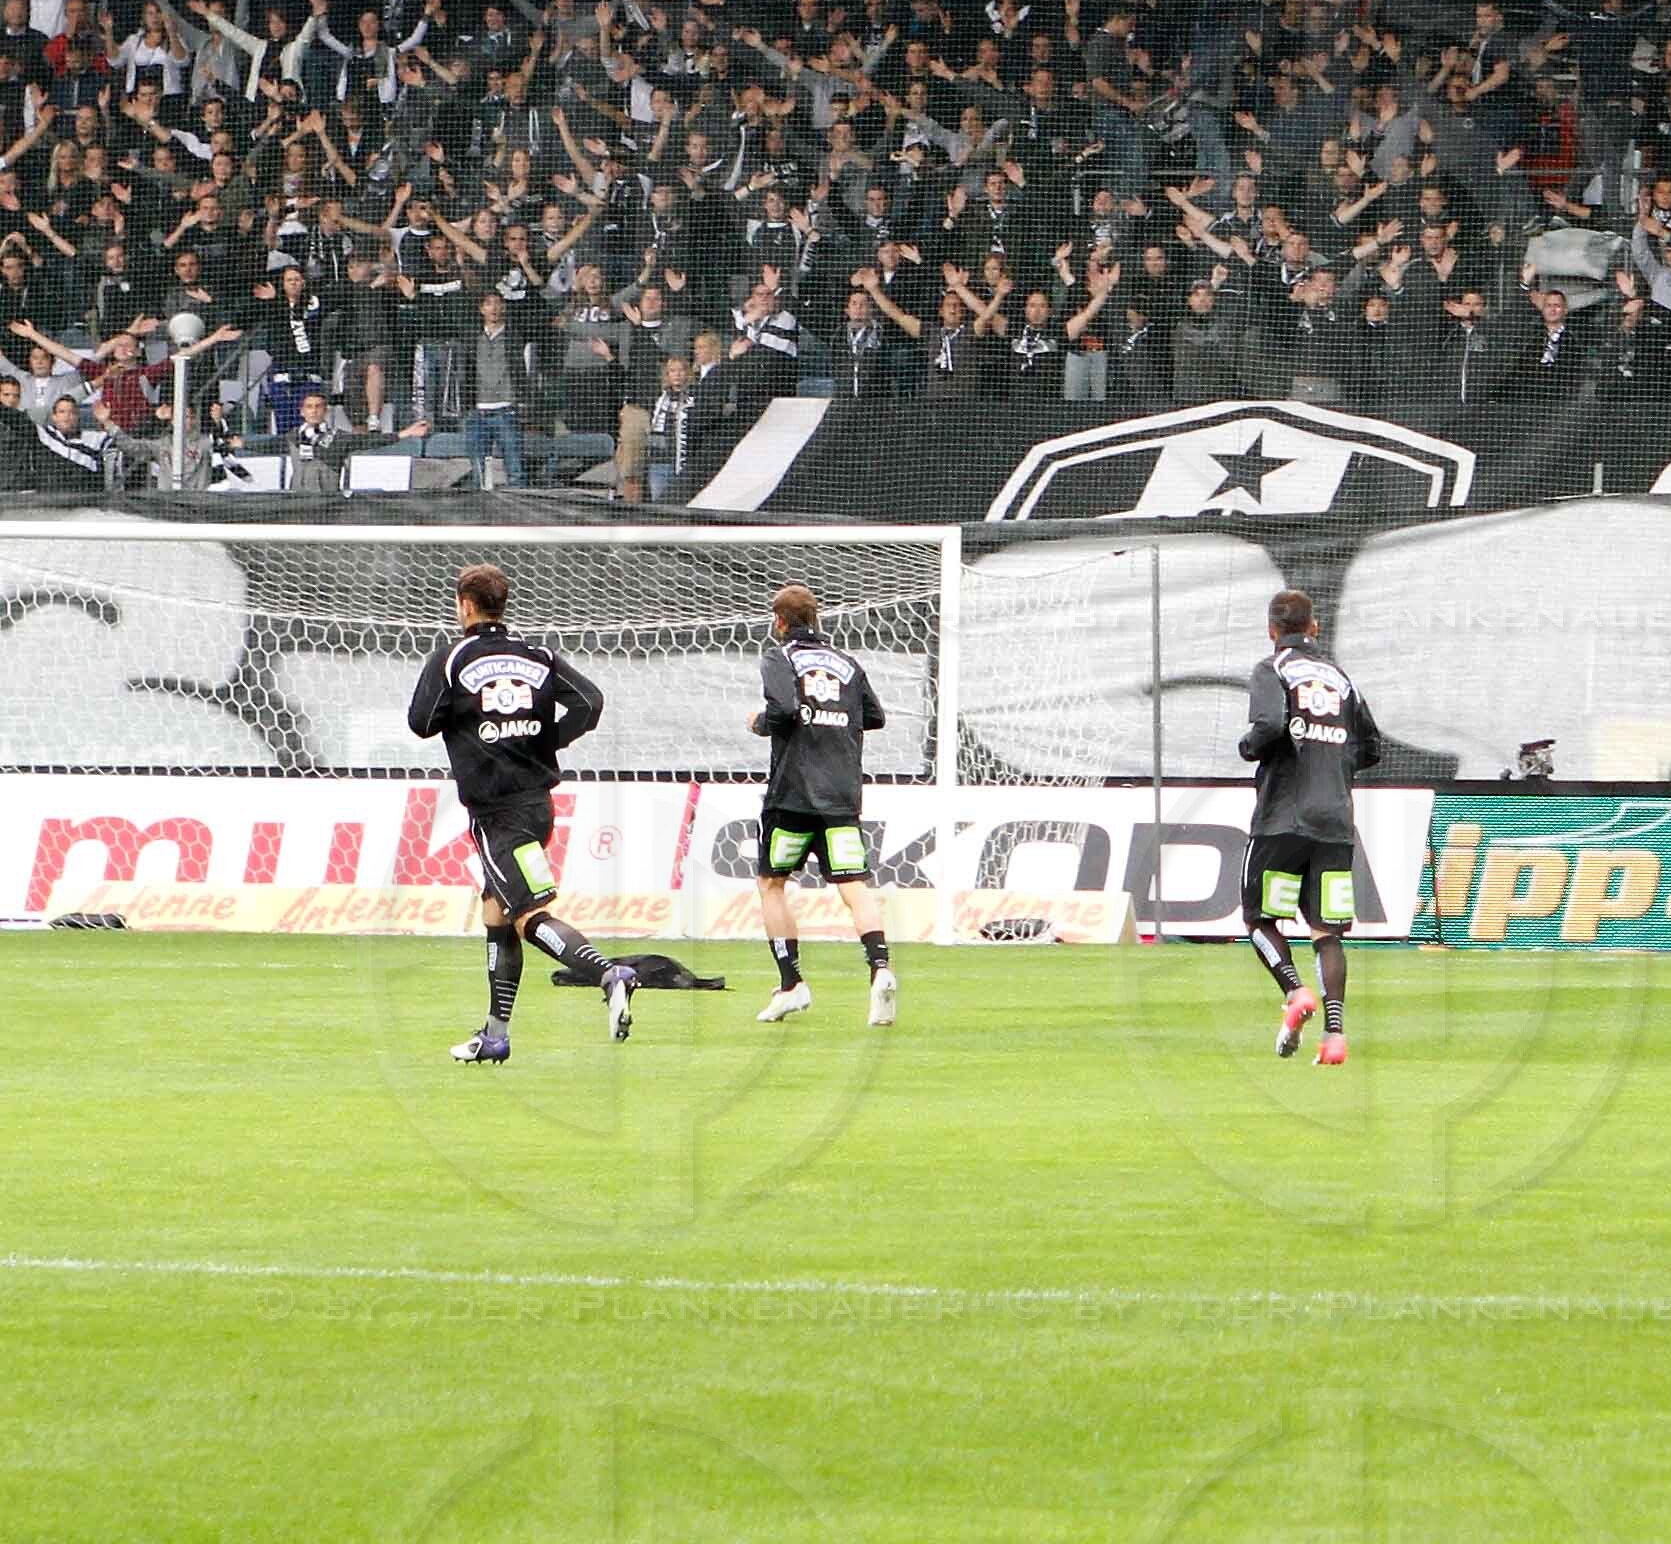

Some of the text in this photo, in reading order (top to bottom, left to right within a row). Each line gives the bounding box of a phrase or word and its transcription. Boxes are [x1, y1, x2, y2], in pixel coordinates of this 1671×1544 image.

[466, 660, 543, 686] PUNTIGAMER
[500, 719, 542, 739] JAKO
[812, 710, 849, 727] JAKO
[1306, 722, 1348, 744] JAKO
